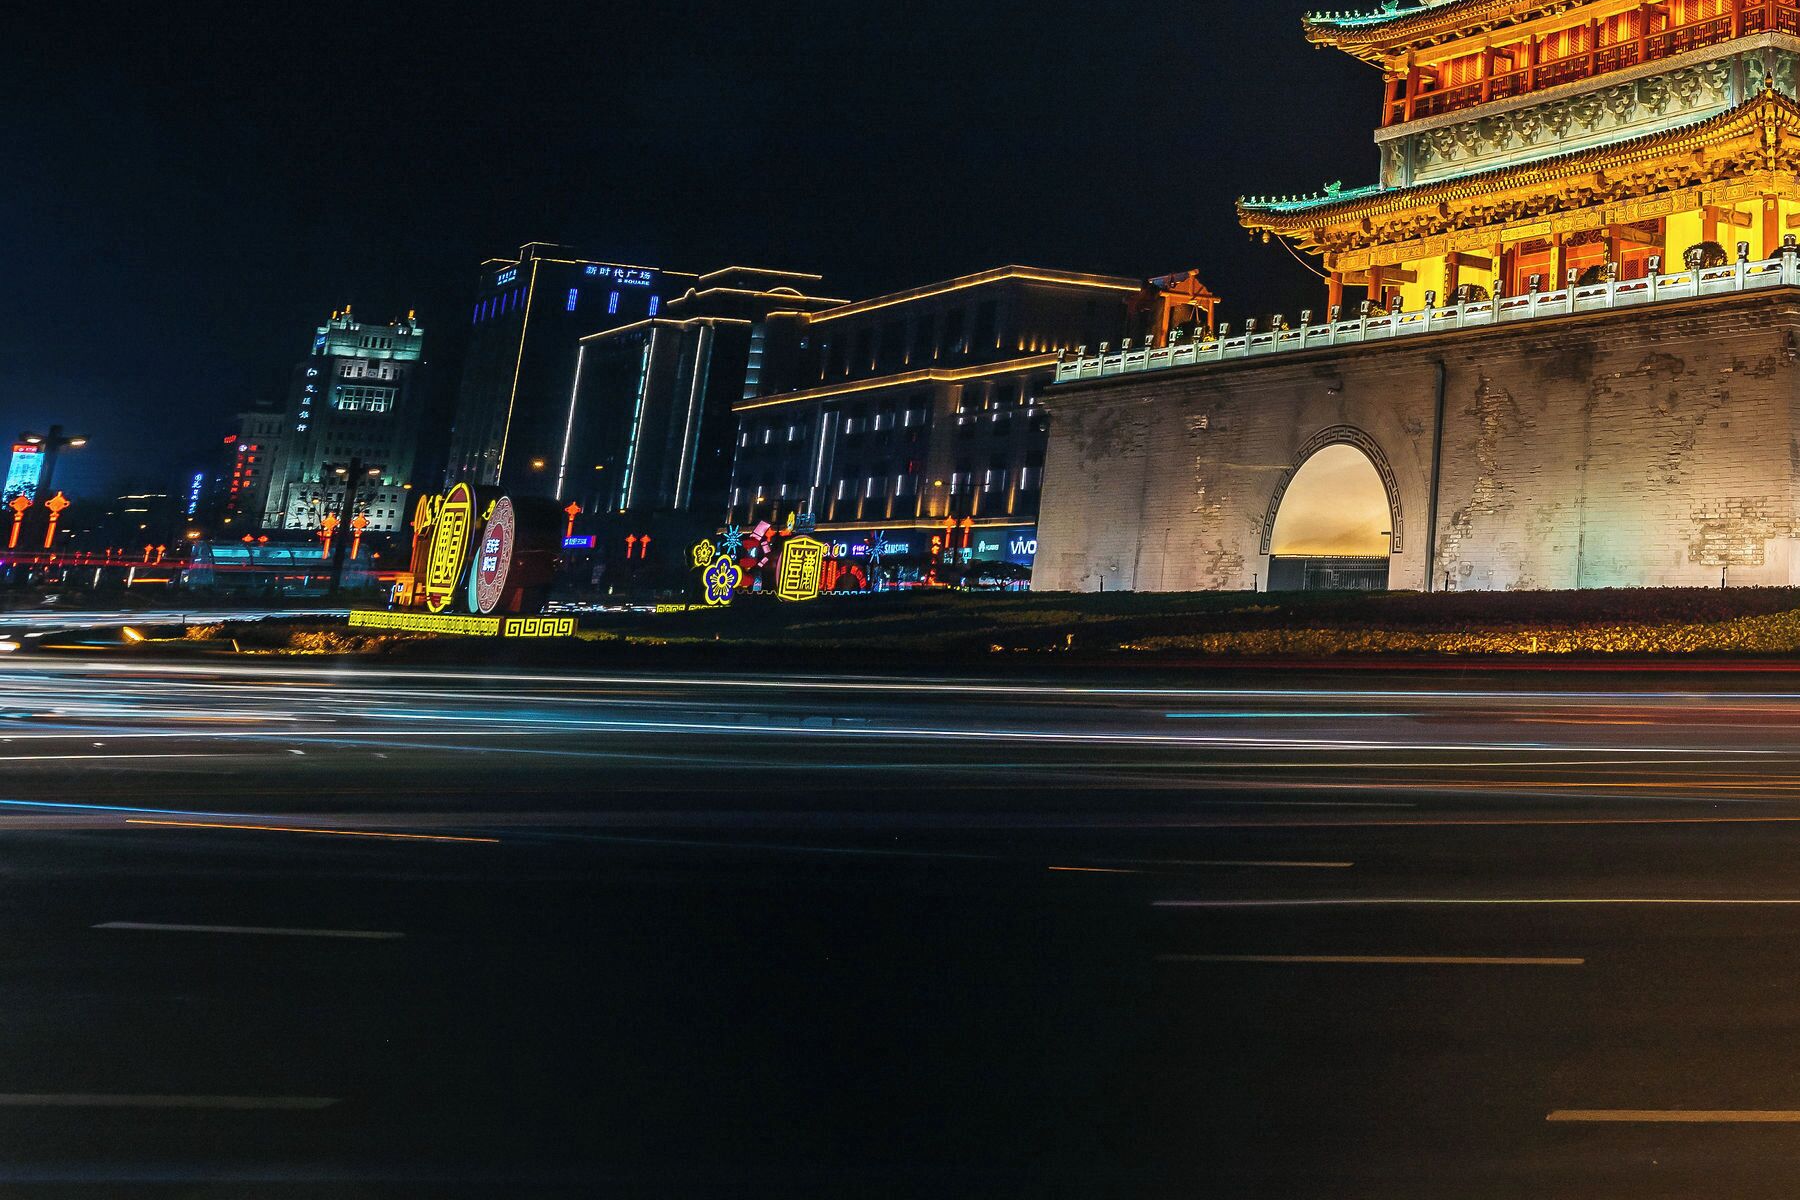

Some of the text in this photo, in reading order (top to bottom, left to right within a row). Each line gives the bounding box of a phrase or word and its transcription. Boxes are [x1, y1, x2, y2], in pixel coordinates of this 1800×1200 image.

[586, 266, 650, 279] 新时代广场
